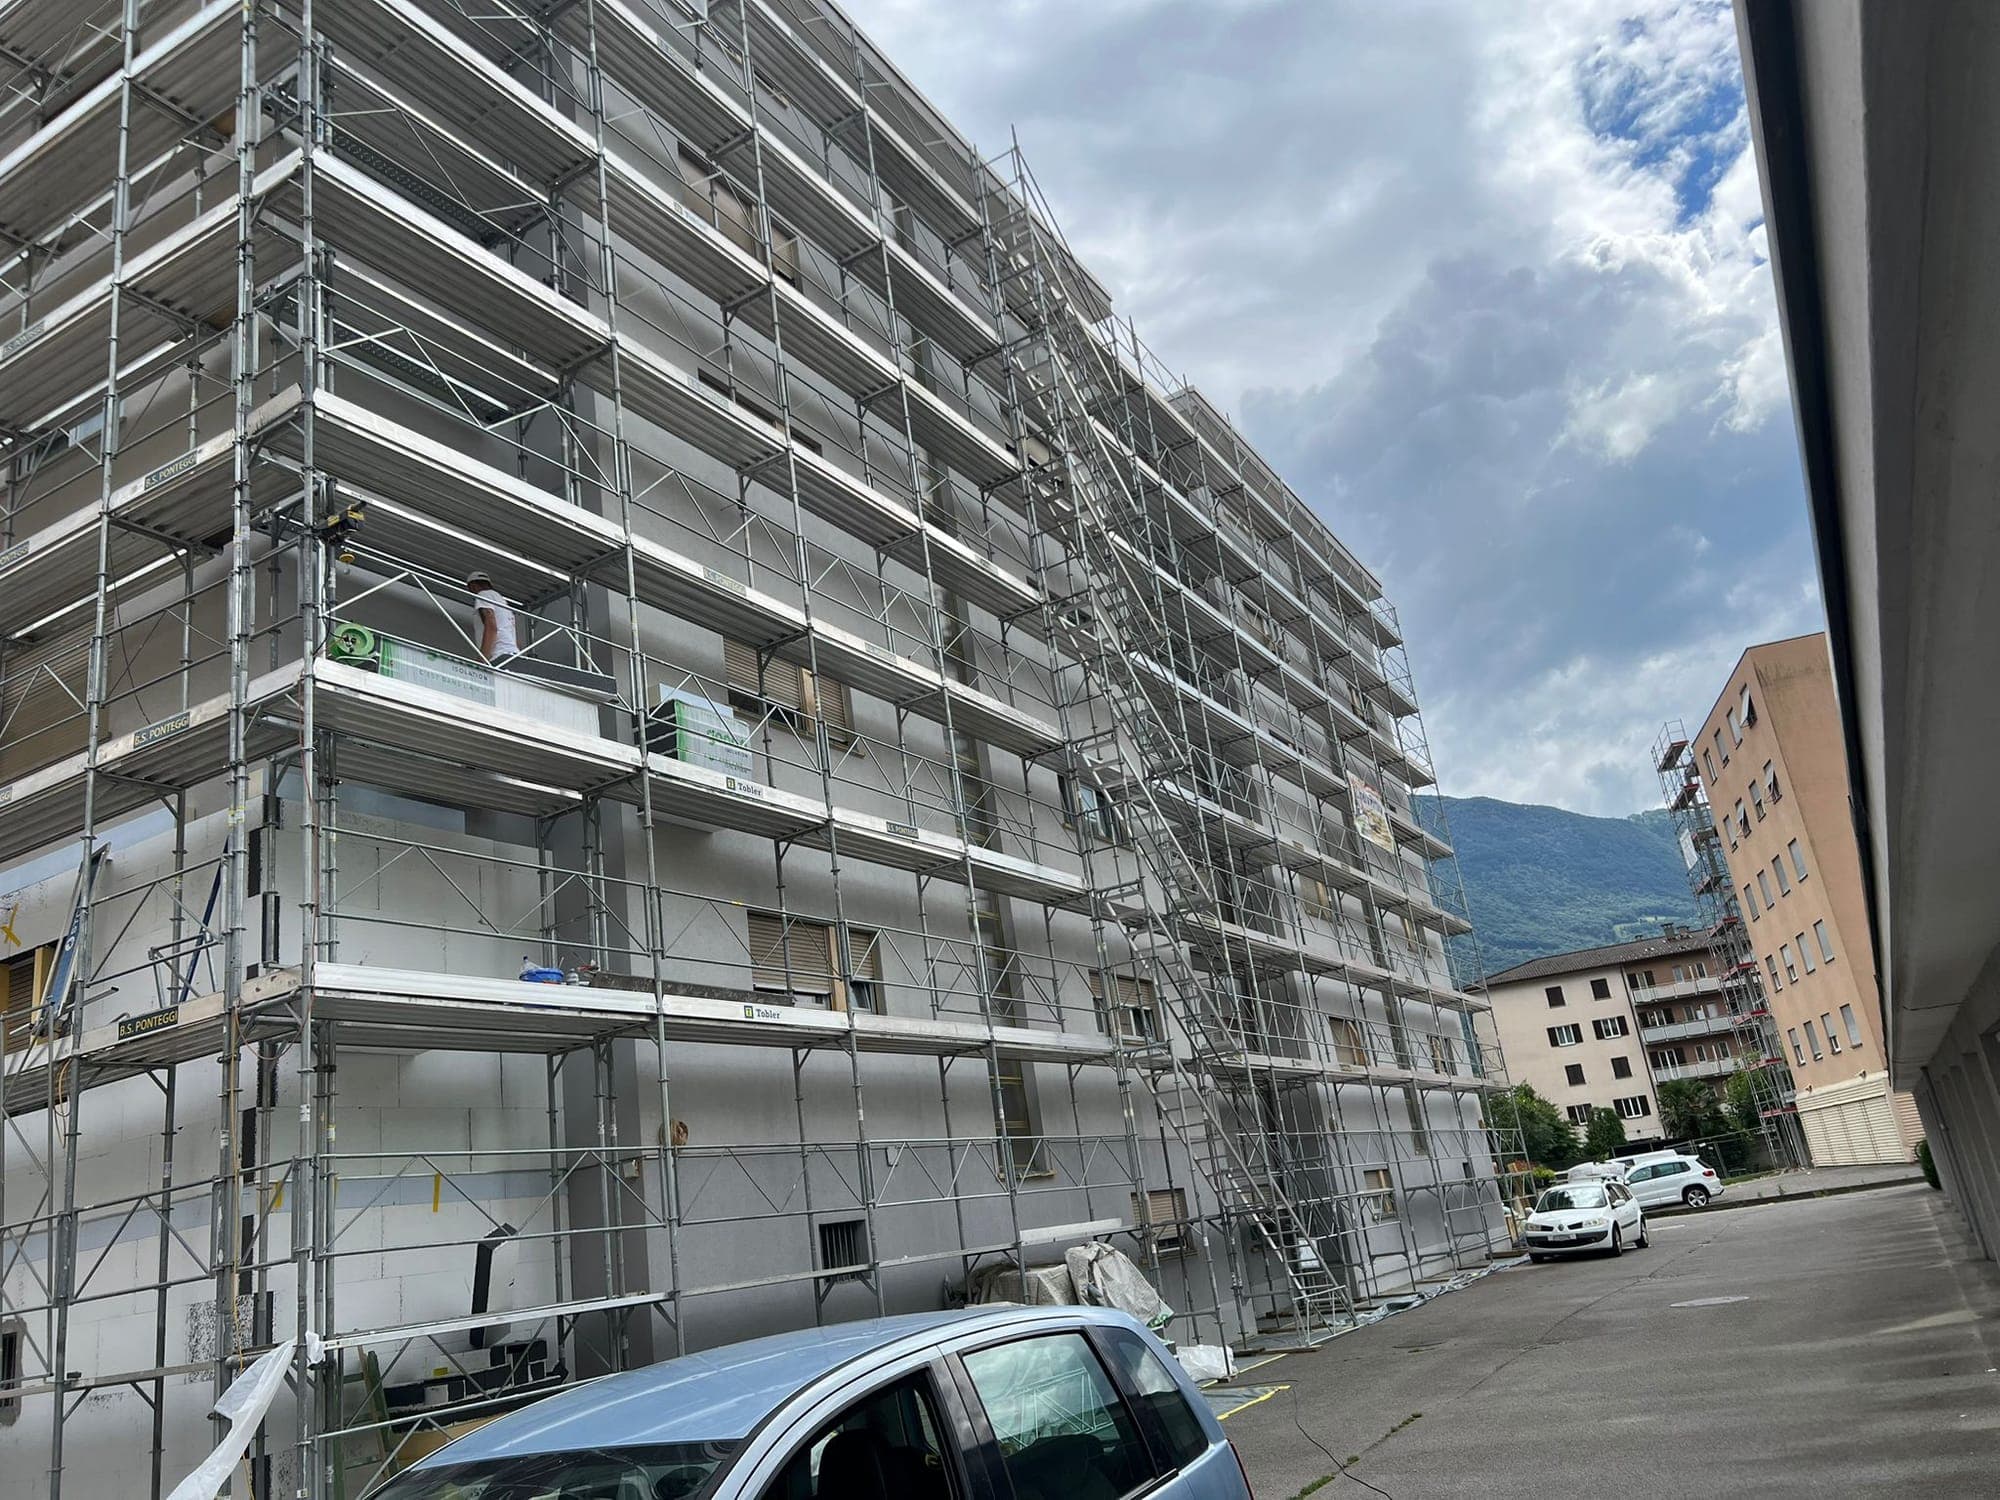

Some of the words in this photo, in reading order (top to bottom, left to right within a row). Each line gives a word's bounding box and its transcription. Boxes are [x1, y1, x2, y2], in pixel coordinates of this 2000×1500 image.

[737, 782, 761, 796] Tobler
[755, 1008, 780, 1019] Tobler
[120, 1023, 134, 1036] B.S.
[135, 1010, 178, 1032] PONTEGGI
